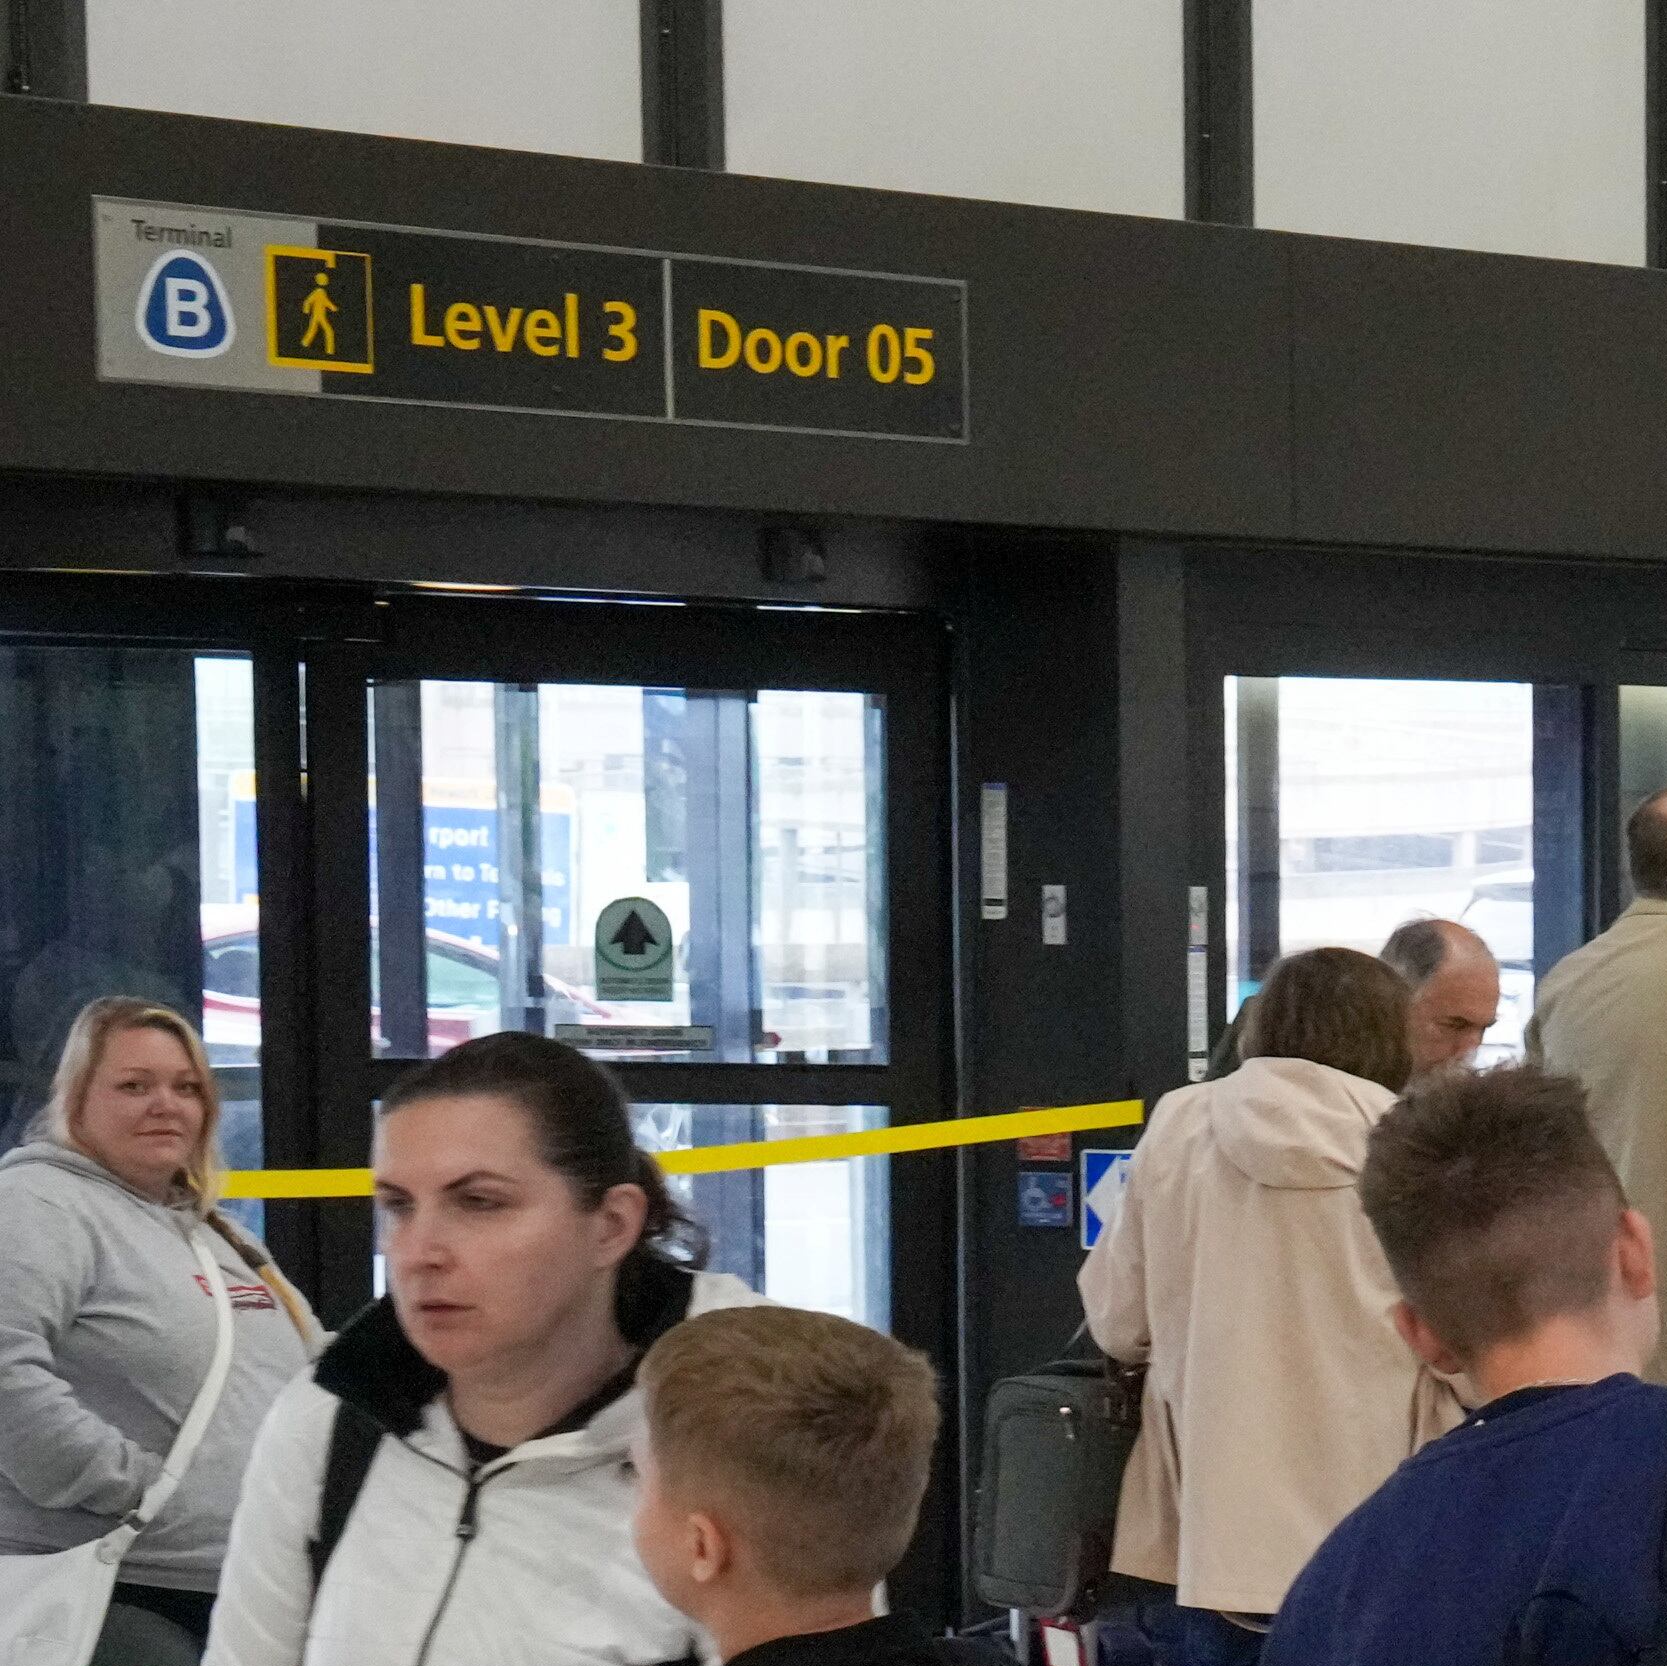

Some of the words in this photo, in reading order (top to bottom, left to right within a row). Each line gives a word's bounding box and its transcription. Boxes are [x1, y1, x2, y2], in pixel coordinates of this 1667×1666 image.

[131, 219, 232, 249] Terminal
[165, 277, 212, 338] B
[409, 282, 581, 358] Level
[602, 300, 639, 362] 3
[698, 308, 850, 379] Door
[866, 323, 936, 385] 05
[427, 826, 490, 848] rport
